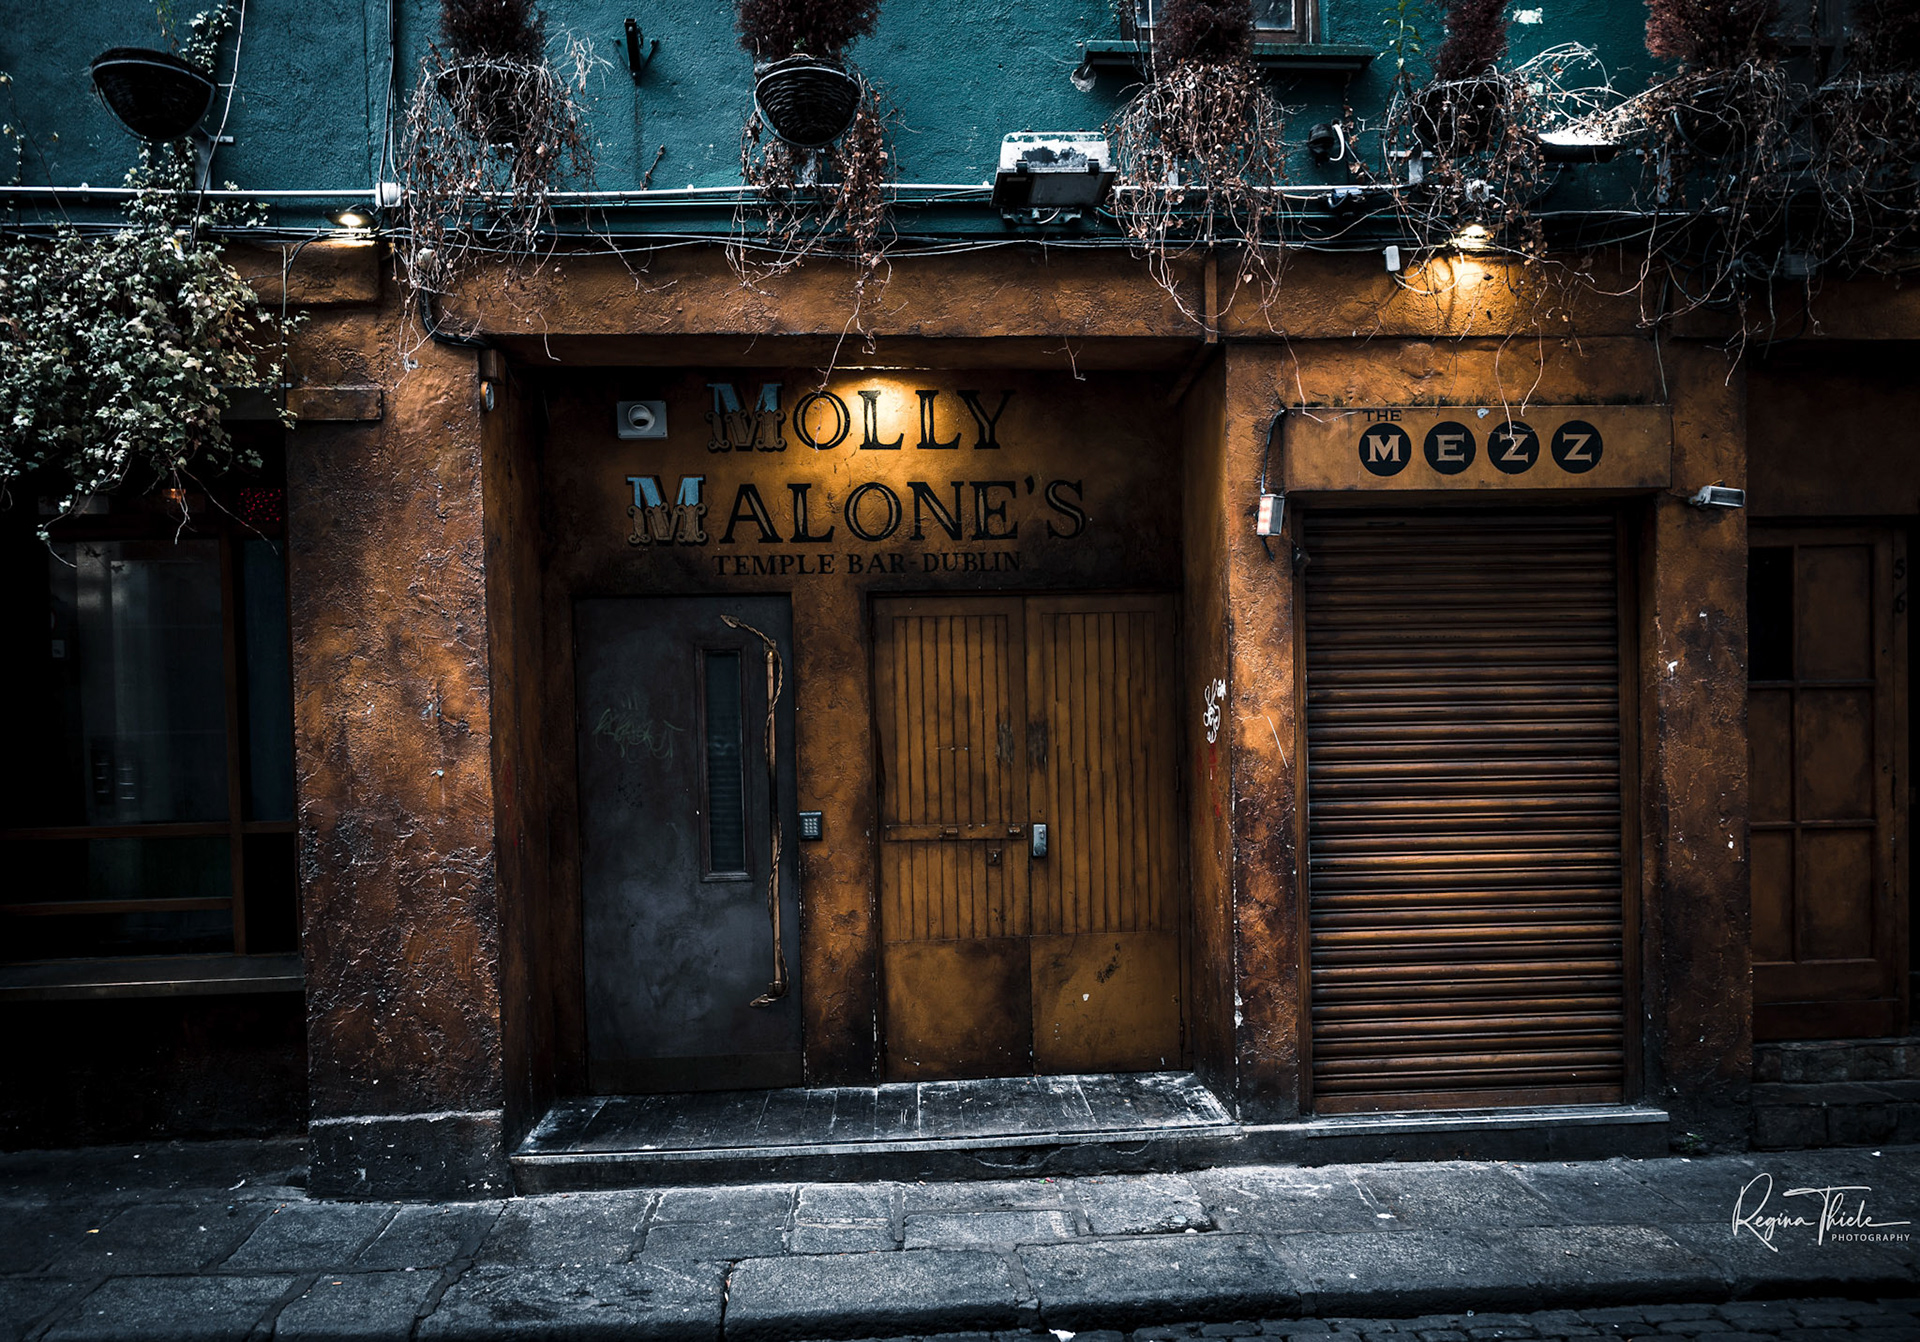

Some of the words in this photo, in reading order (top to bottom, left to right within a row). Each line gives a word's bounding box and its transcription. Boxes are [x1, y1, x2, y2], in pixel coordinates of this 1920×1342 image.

[704, 382, 1017, 454] MOLLY
[1363, 410, 1402, 422] THE
[1364, 430, 1595, 464] MEZZ
[624, 474, 1088, 548] MALONE'S
[711, 553, 836, 576] TEMPLE
